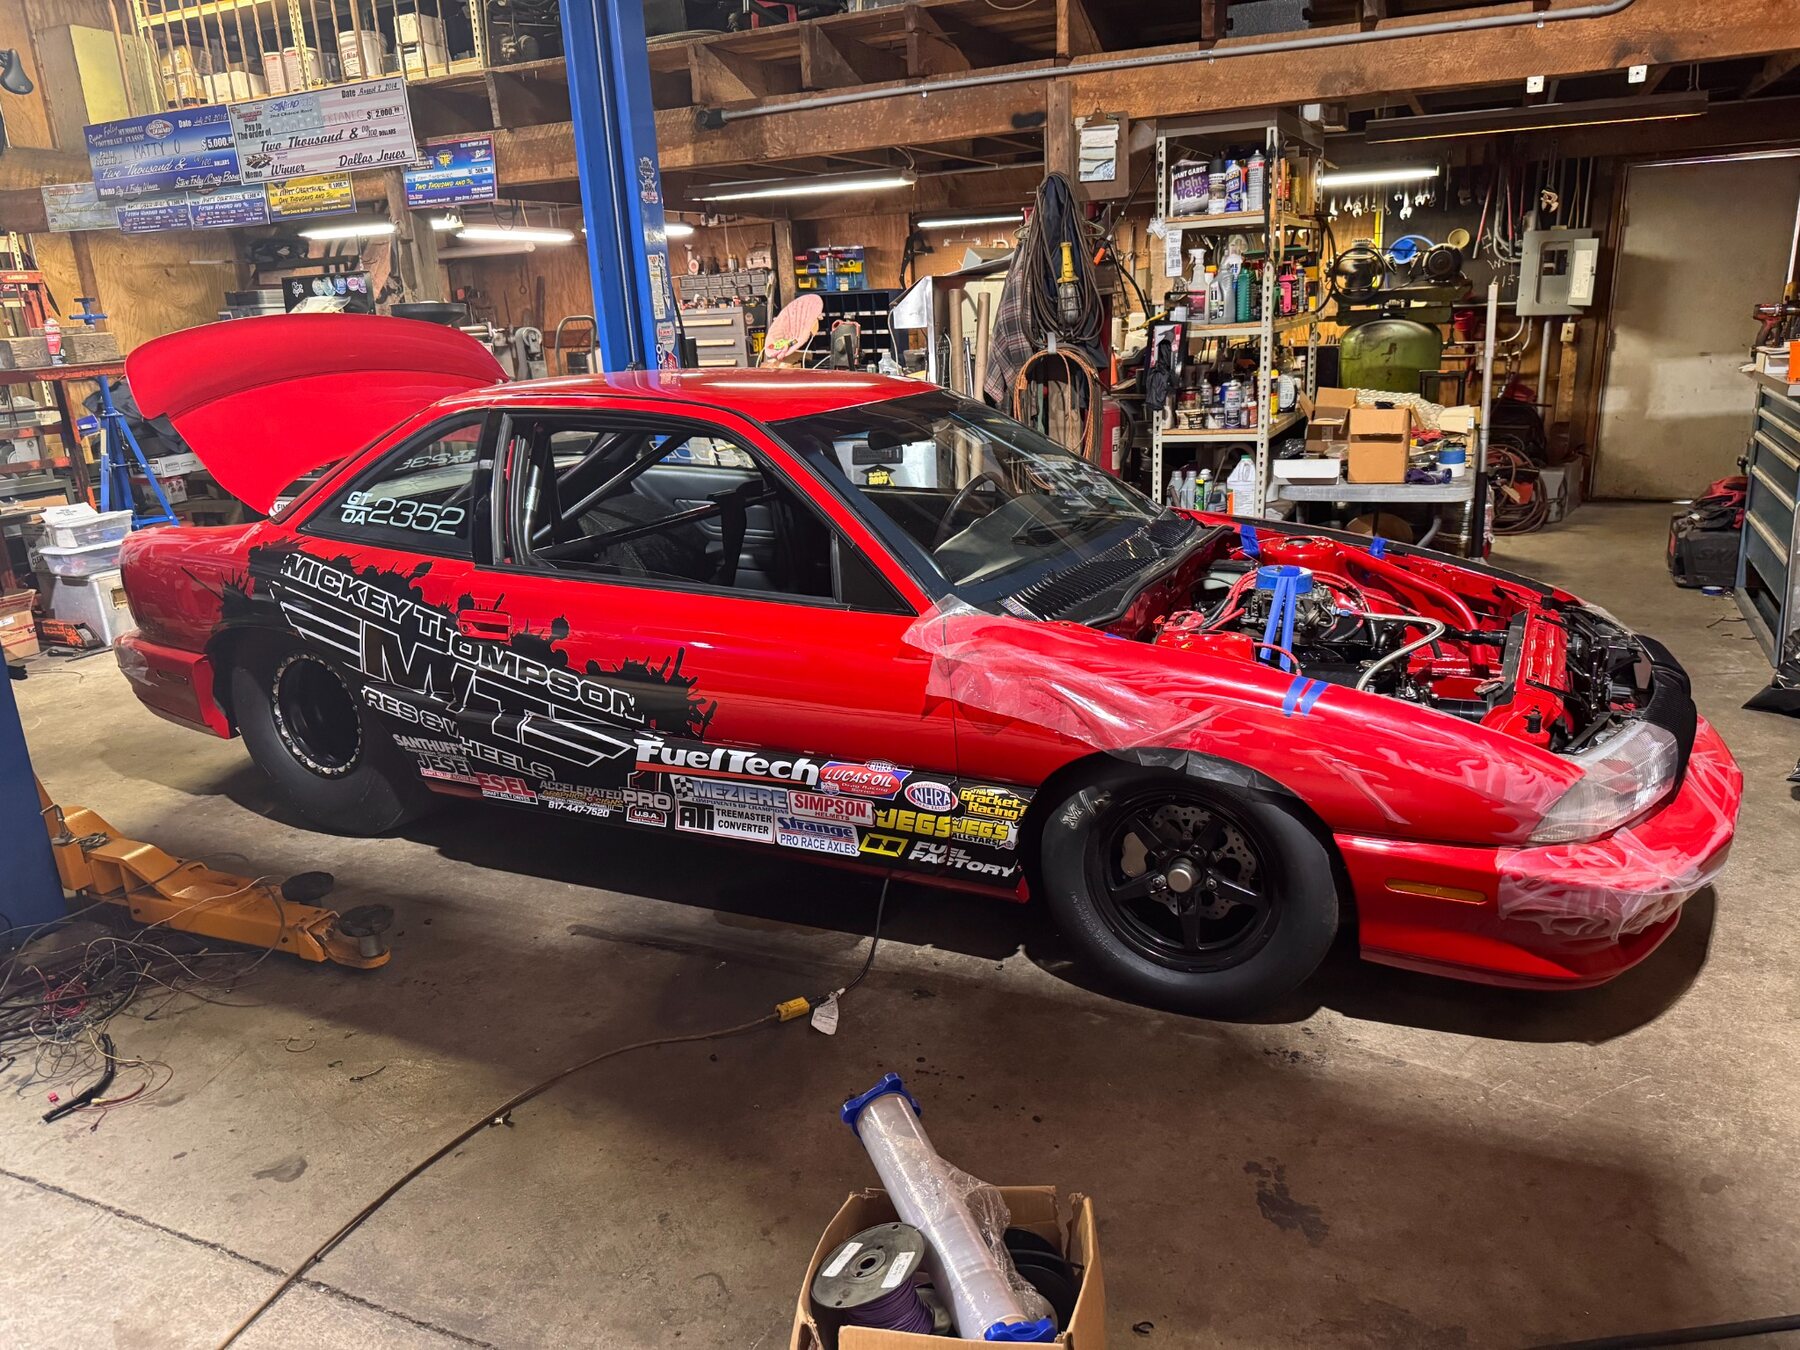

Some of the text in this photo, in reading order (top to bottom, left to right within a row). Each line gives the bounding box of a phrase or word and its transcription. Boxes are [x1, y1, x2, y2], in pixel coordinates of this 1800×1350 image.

[342, 89, 356, 98] Date
[178, 120, 192, 128] Date
[238, 128, 272, 140] The order of
[260, 140, 282, 152] Two
[288, 130, 344, 148] Thousand
[349, 127, 358, 138] &
[132, 142, 165, 159] MATTY
[338, 150, 406, 168] Dallas Jones
[102, 168, 122, 178] Five
[125, 160, 172, 176] Thousand
[174, 158, 188, 170] &
[245, 164, 306, 180] Memo Winner
[341, 510, 366, 525] OA
[347, 491, 466, 536] GT 2352
[280, 552, 414, 625] MICKEY
[417, 752, 477, 778] JESEL
[633, 738, 820, 786] FuelTech
[476, 772, 536, 796] ESEL
[824, 768, 892, 788] LUCAS OIL
[540, 780, 622, 800] ACCELERATED
[622, 788, 672, 810] PRO
[692, 780, 788, 808] MEZIERE
[914, 788, 951, 806] NHRA
[960, 790, 1020, 808] Bracket
[548, 801, 610, 818] 817-447-7520
[634, 810, 659, 820] U.S.A.
[692, 797, 738, 808] COMPONENTS
[748, 804, 788, 815] CHAMPIONS
[794, 794, 867, 818] SIMPSON
[716, 808, 772, 824] TREEMASTER
[814, 811, 850, 821] HELMETS
[876, 808, 950, 838] JEGS
[718, 820, 769, 835] CONVERTER
[777, 816, 853, 838] Strange
[952, 818, 1008, 841] JEG'S
[780, 834, 857, 855] PRO RACE AXLES
[952, 832, 998, 846] ALLSTARS
[914, 841, 972, 860] FUEL
[908, 850, 1016, 878] FACTORY
